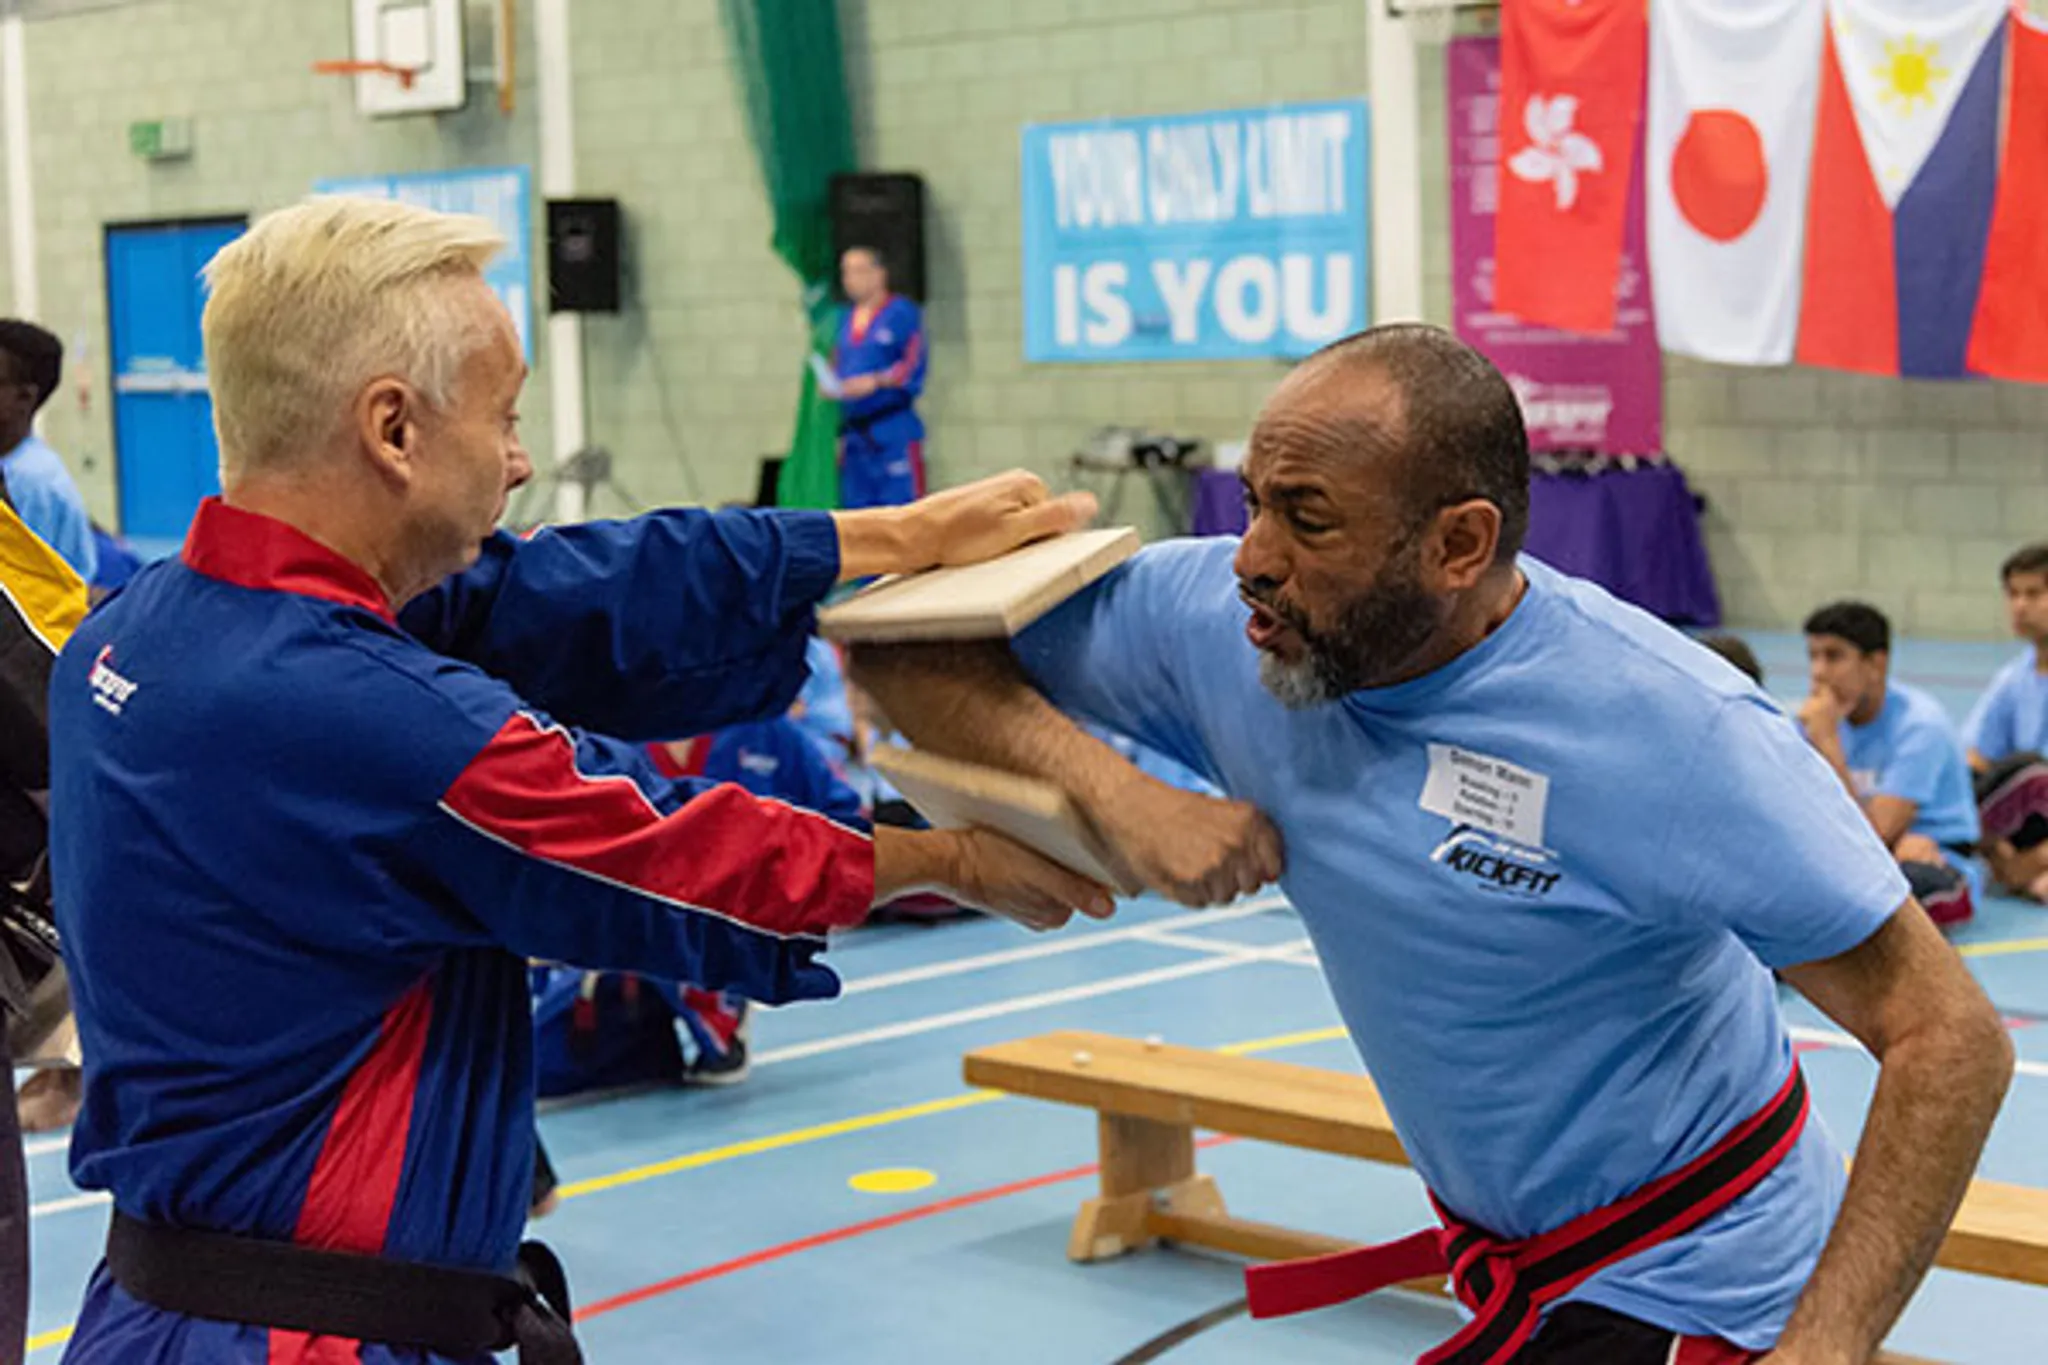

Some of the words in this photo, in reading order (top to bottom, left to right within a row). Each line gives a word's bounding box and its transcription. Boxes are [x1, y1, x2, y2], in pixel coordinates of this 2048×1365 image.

[1053, 261, 1135, 346] IS
[1151, 253, 1354, 344] YOU
[1447, 845, 1561, 893] KICKFIT
